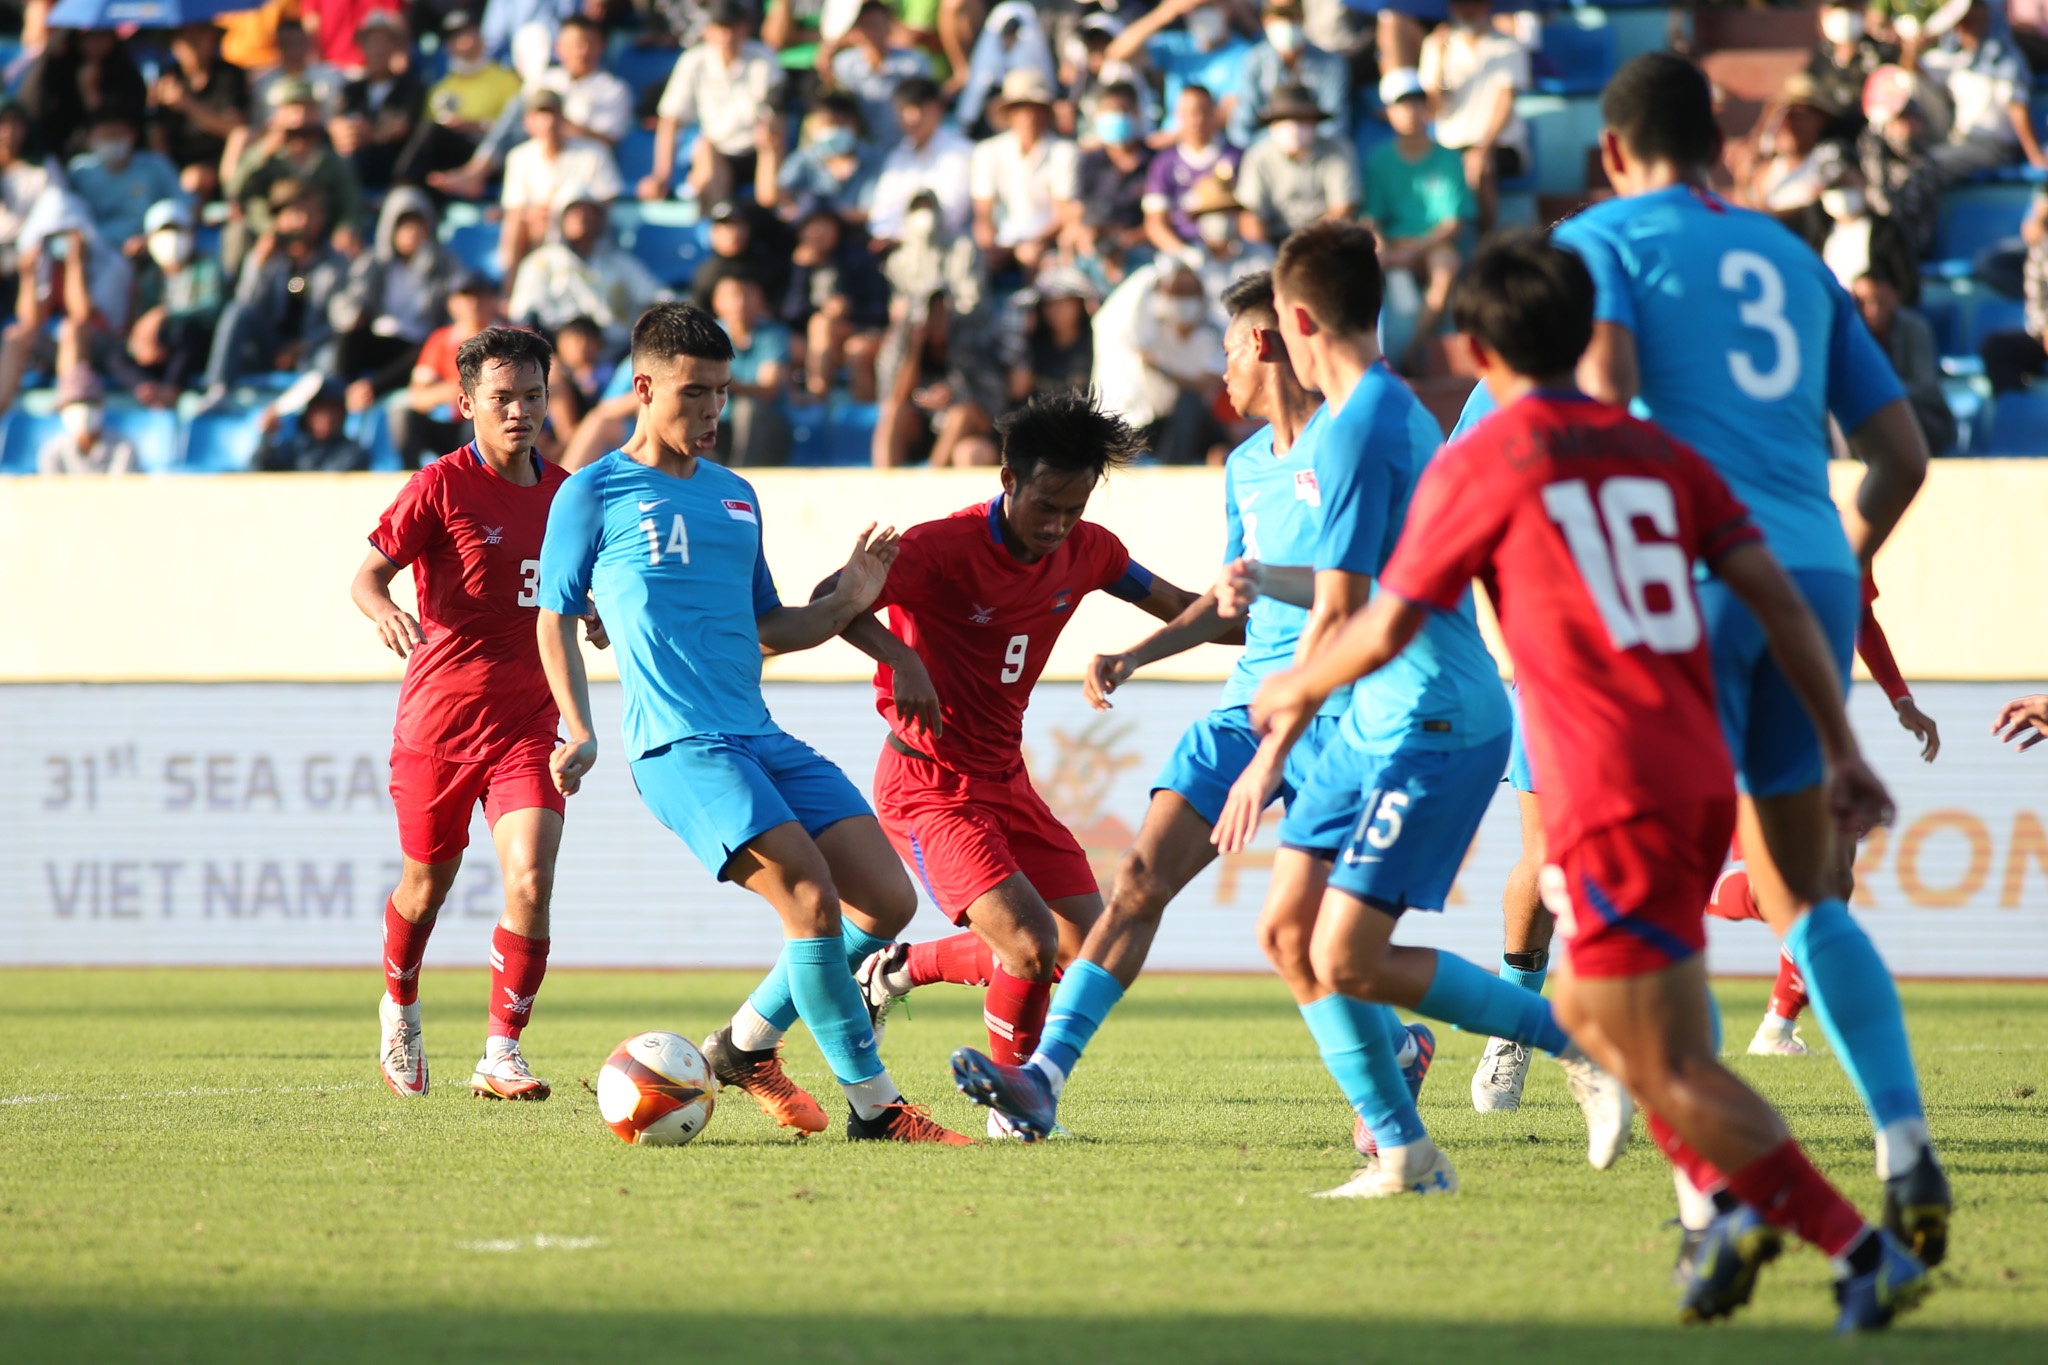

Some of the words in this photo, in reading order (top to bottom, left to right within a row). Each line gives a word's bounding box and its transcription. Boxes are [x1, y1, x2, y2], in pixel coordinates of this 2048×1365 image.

[1719, 249, 1800, 400] 3
[638, 513, 690, 565] 14
[1541, 475, 1700, 654] 16
[517, 559, 541, 607] 3
[1001, 634, 1029, 684] 9
[163, 754, 285, 812] SEA
[1354, 786, 1409, 850] 15
[45, 858, 185, 921] VIET
[202, 858, 354, 921] NAM
